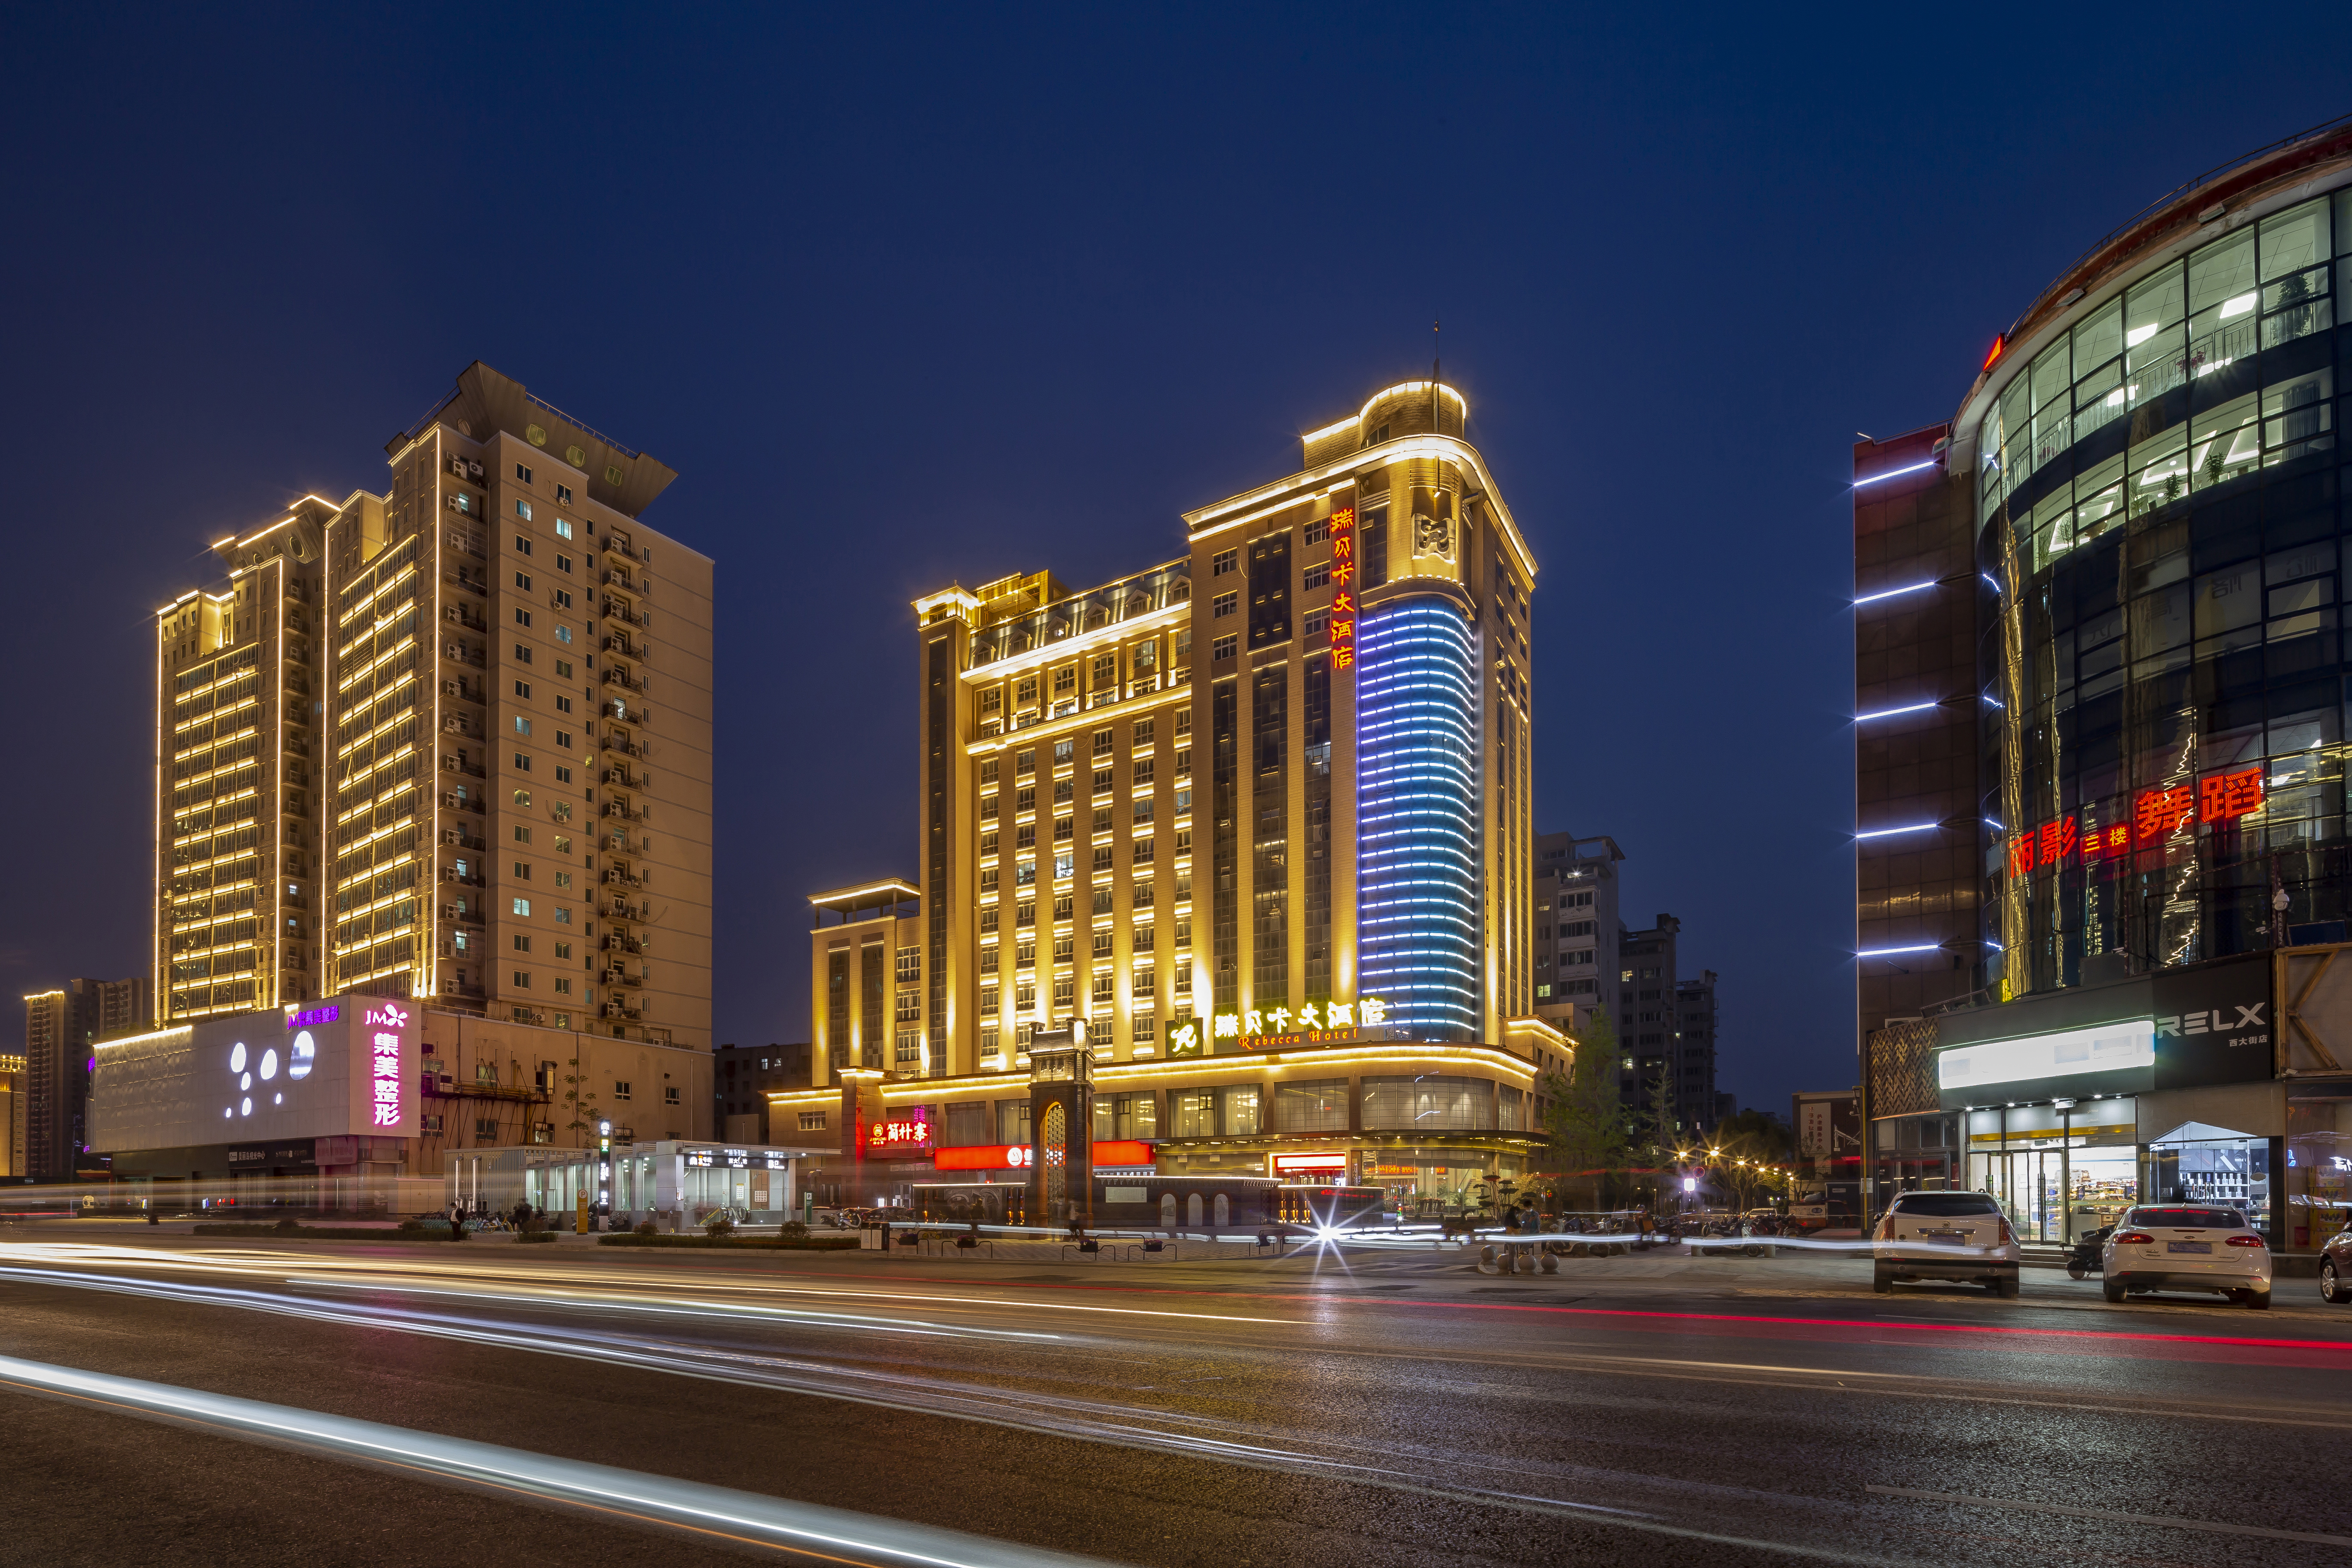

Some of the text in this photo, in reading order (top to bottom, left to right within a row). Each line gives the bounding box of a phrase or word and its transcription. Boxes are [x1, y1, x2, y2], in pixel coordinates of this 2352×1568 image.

[1331, 508, 1354, 670] 瑞贝卡大酒店
[2084, 827, 2126, 853] 三楼
[2138, 767, 2262, 839] 舞蹈
[365, 1010, 387, 1025] JM
[1215, 998, 1385, 1037] 瑞贝卡大酒店
[2157, 1002, 2266, 1039] RELX
[1238, 1027, 1358, 1050] Rebecca Hotel
[2229, 1035, 2267, 1047] 西大街店
[374, 1032, 400, 1125] 集美整形
[887, 1122, 928, 1142] 简朴寨
